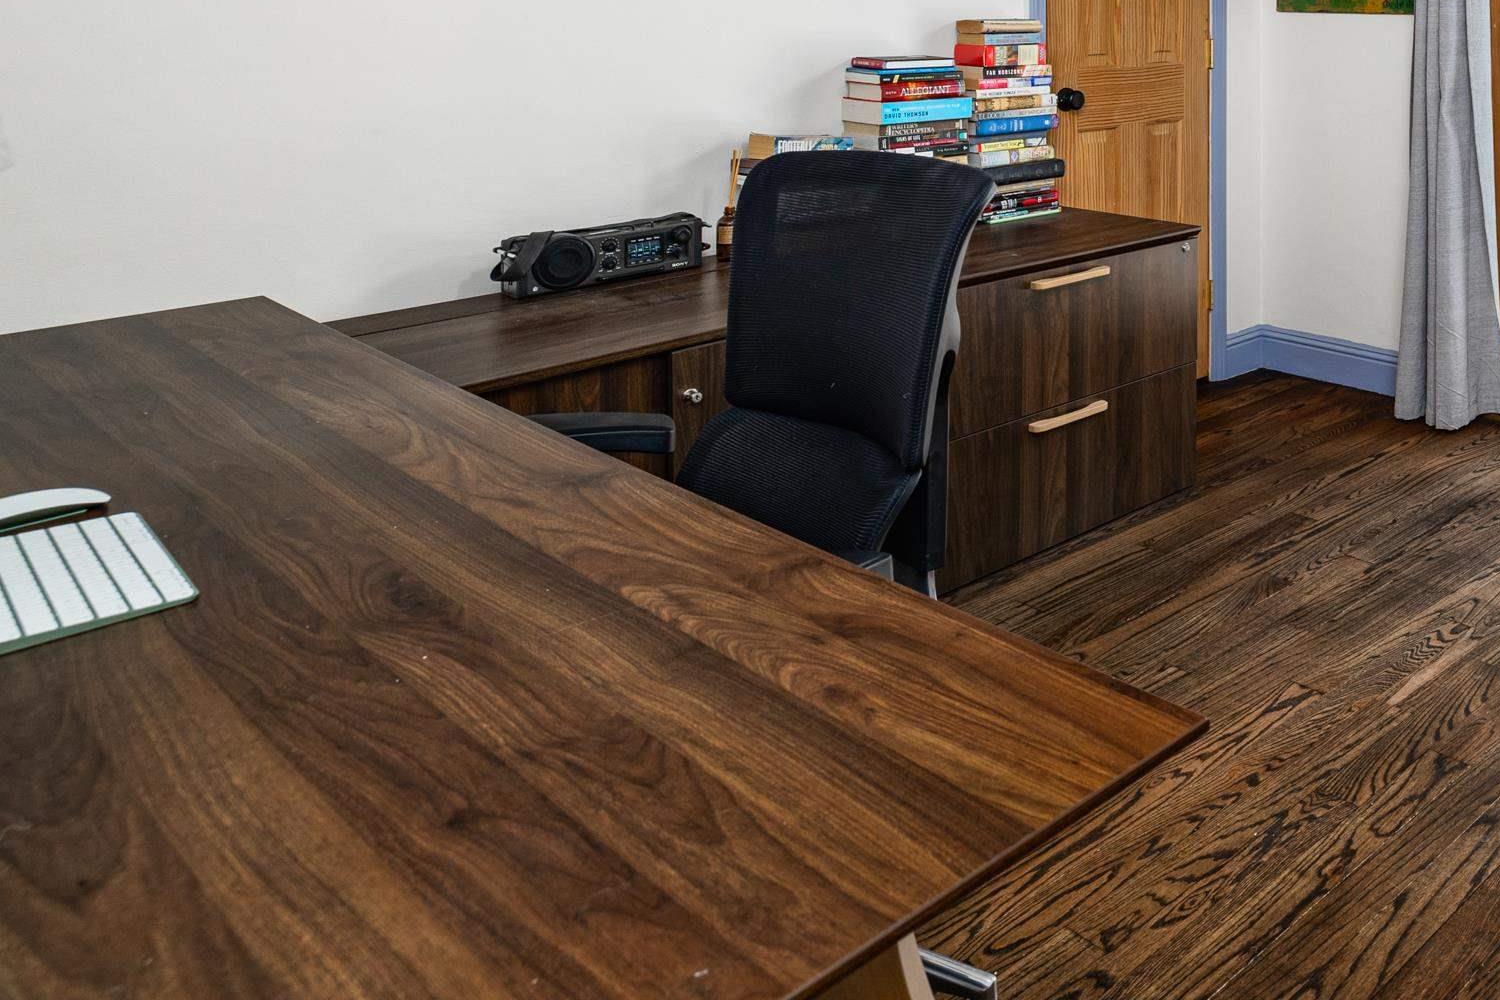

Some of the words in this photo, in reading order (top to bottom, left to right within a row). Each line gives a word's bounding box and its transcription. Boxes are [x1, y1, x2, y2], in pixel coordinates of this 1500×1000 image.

[997, 68, 1024, 76] HORIZONS
[900, 85, 952, 97] ALLEGIANT
[884, 112, 901, 120] DAVID
[903, 110, 929, 118] THOMSON
[891, 127, 935, 137] ENCYCLOPEDIA
